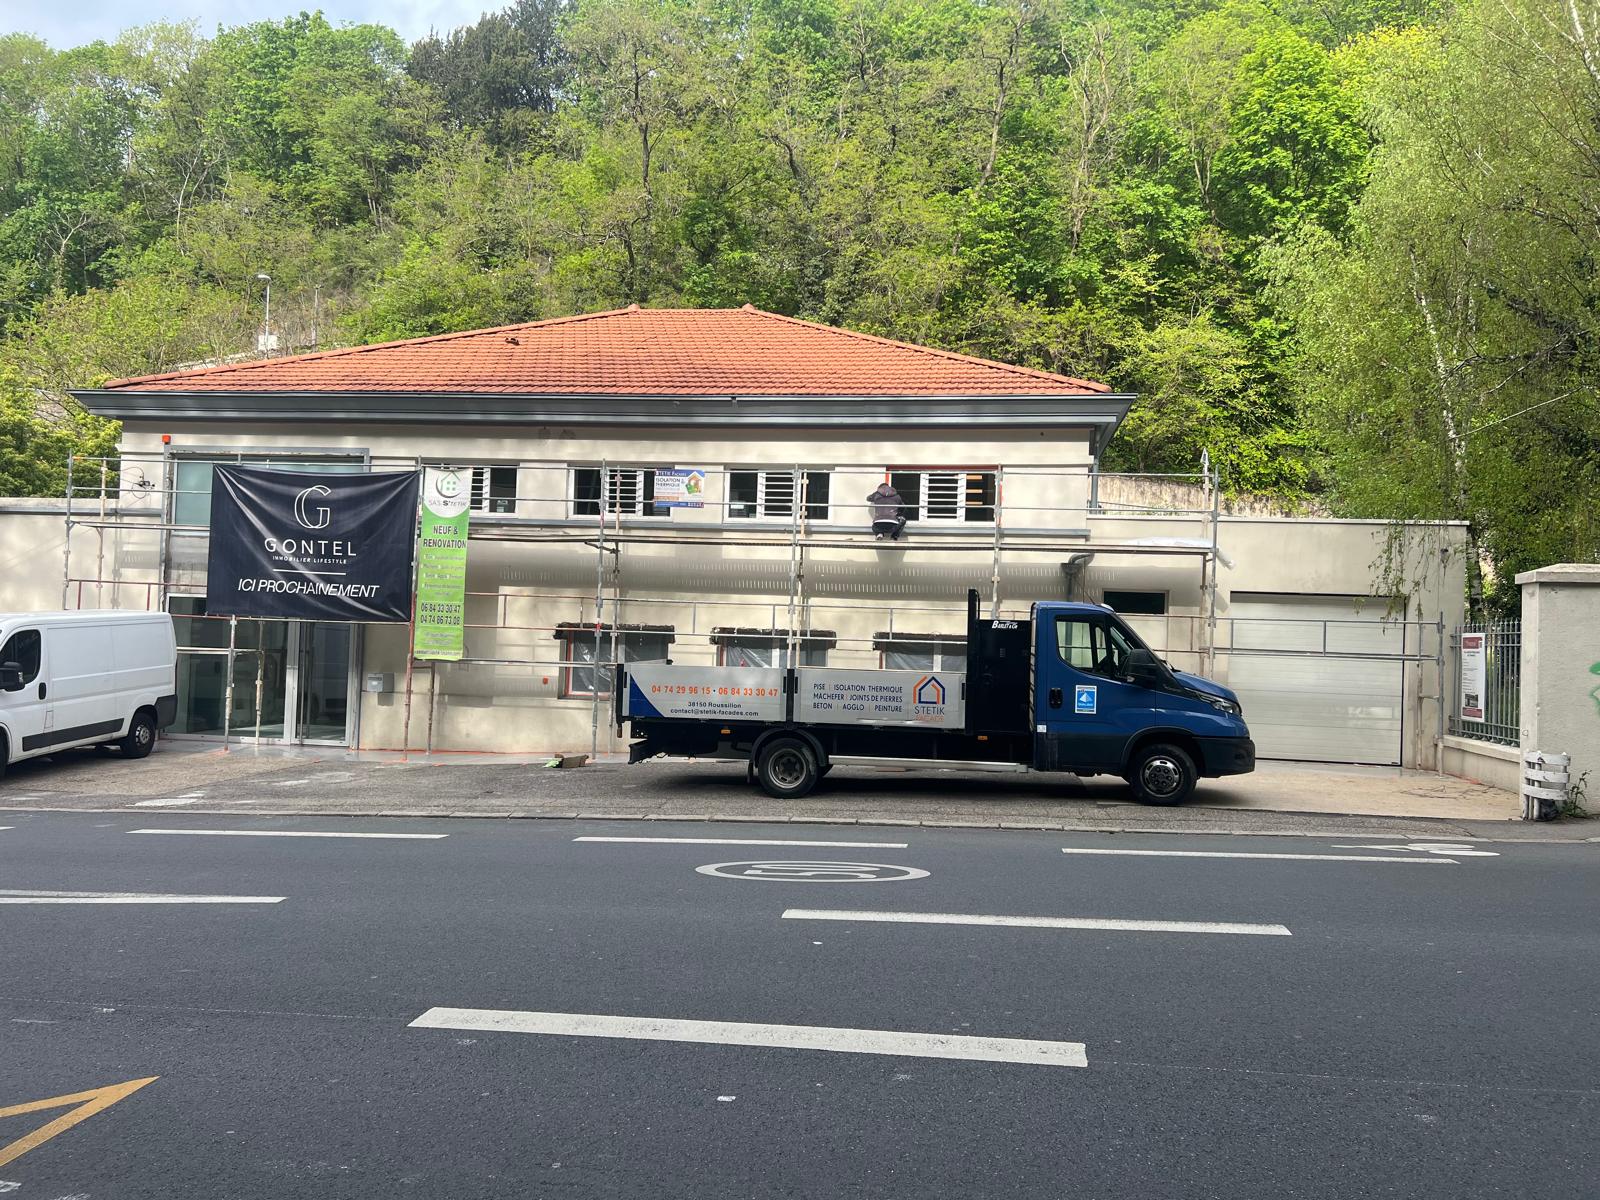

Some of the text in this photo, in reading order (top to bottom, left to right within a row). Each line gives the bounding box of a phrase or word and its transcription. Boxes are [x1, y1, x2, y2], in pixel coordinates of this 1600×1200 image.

[433, 526, 458, 535] NEUF &
[264, 538, 357, 556] GONTEL
[422, 538, 466, 548] RENOVATION
[238, 578, 380, 598] ICI PROCHAINEMENT
[420, 603, 428, 612] 06
[429, 604, 436, 612] 84
[437, 604, 444, 613] 33
[453, 604, 460, 613] 47
[420, 614, 427, 623] 04
[429, 615, 436, 623] 74
[445, 616, 452, 624] 73
[652, 685, 661, 693] 04
